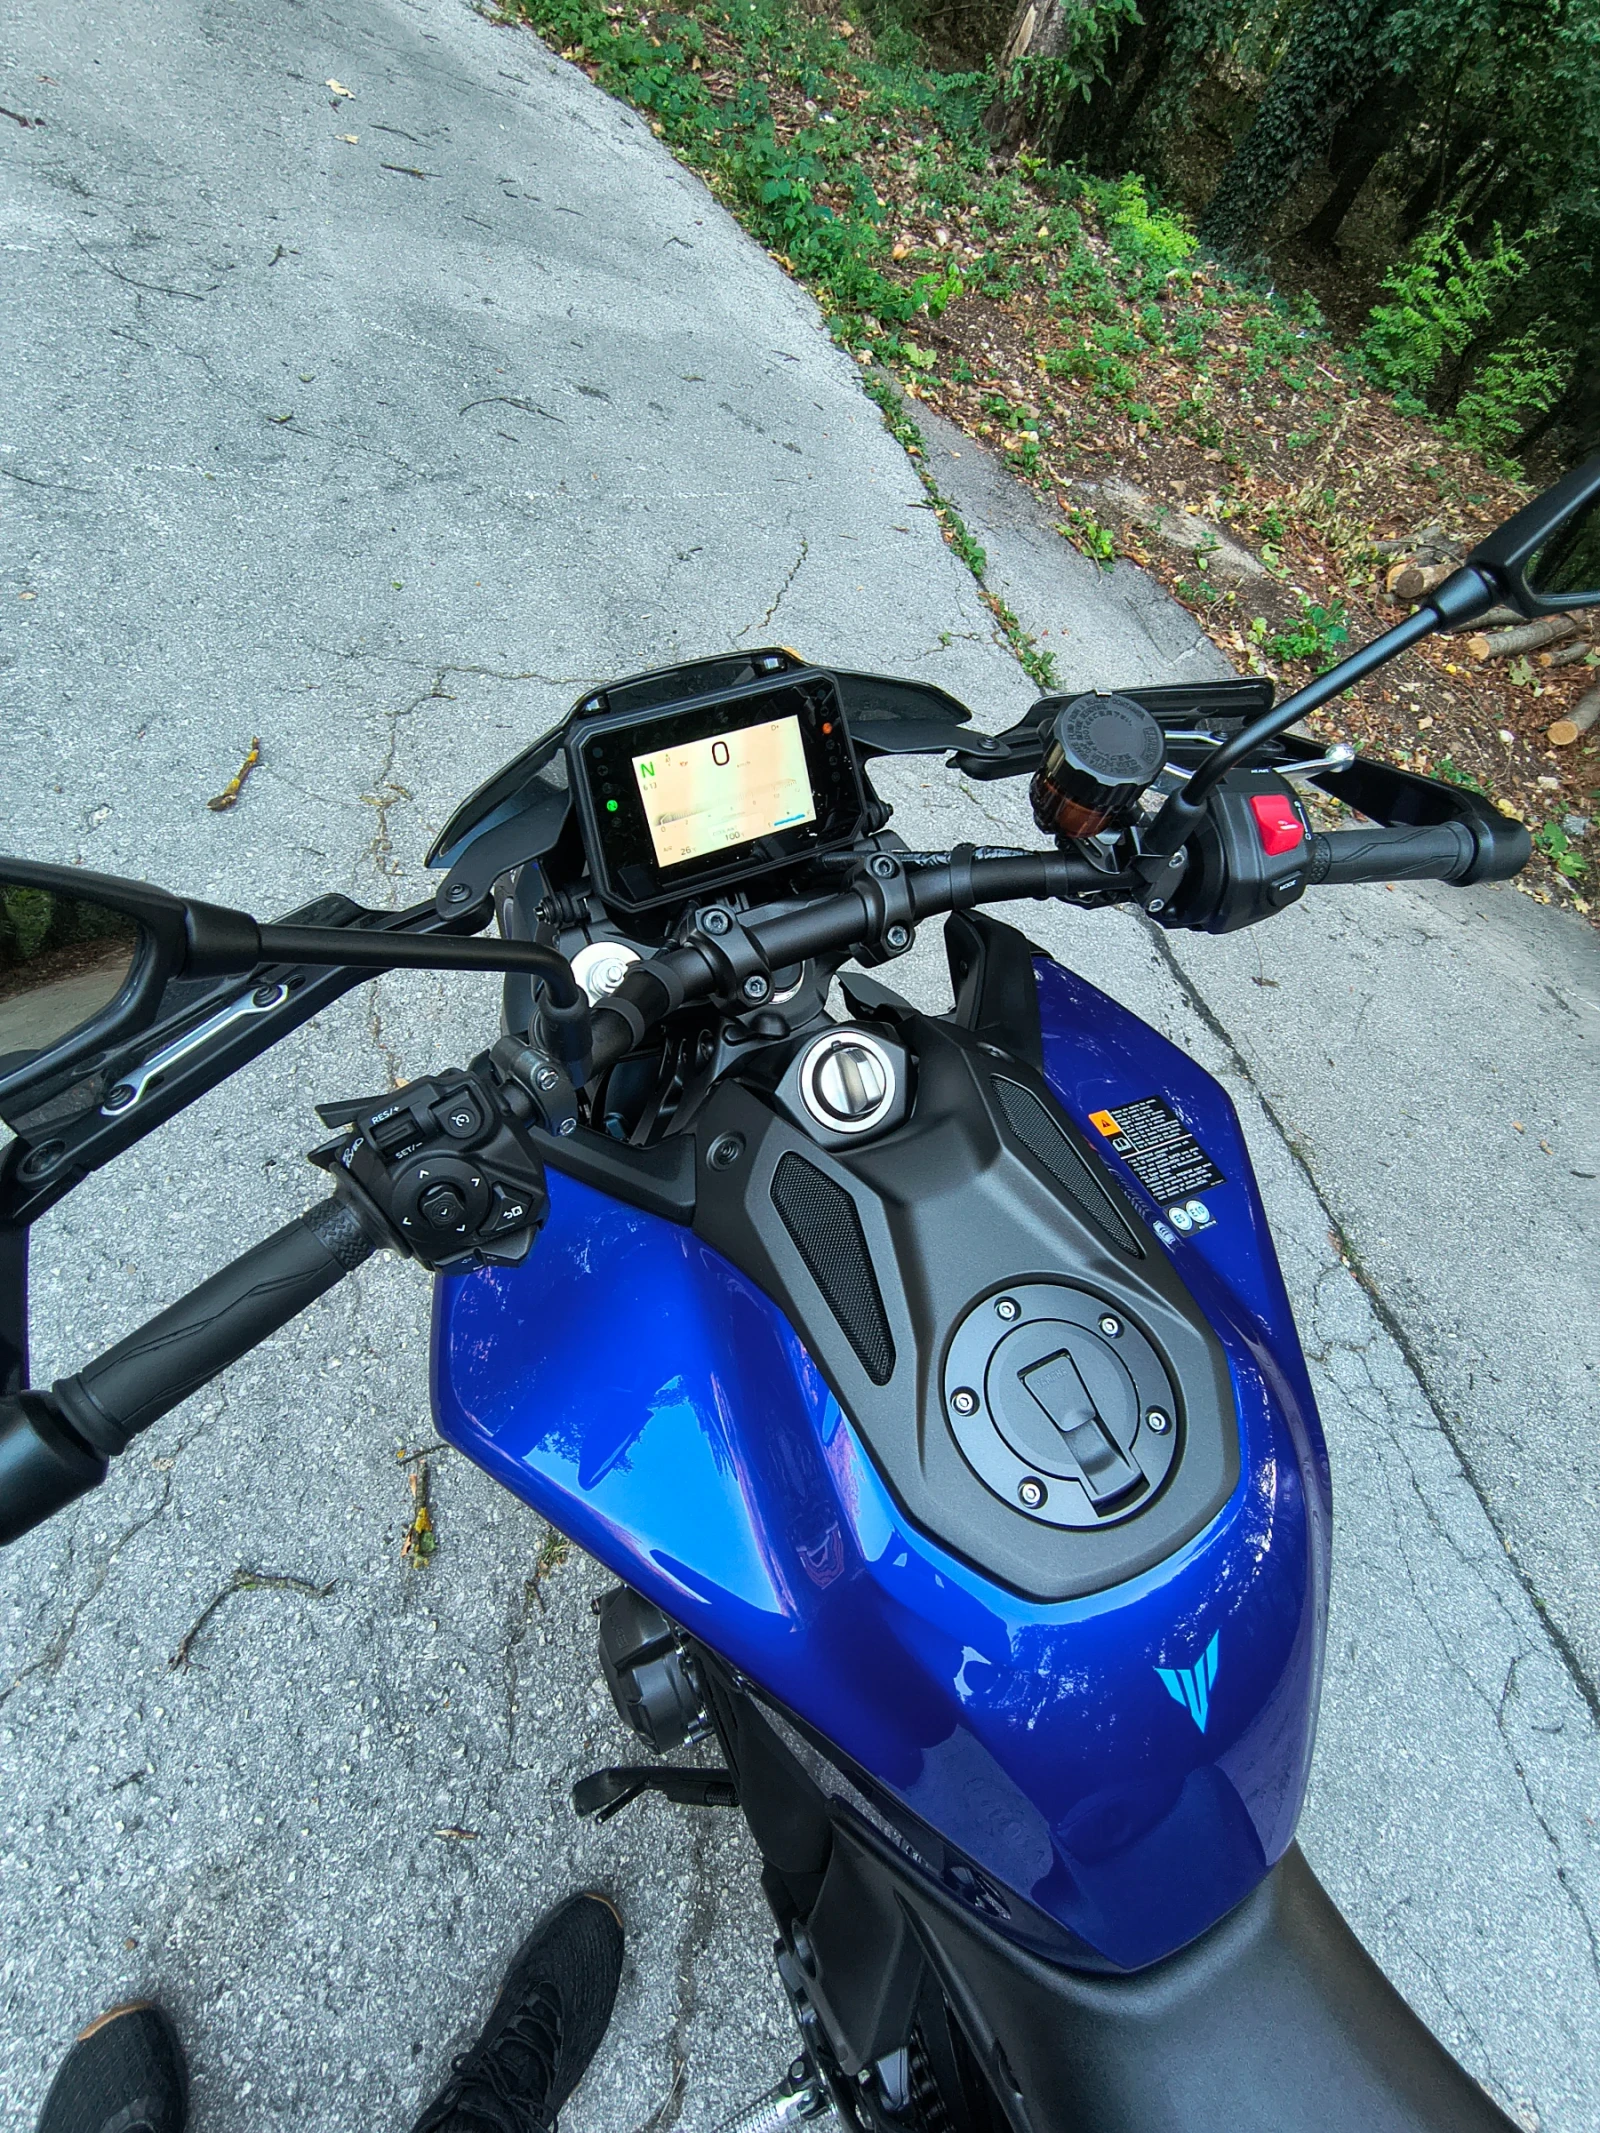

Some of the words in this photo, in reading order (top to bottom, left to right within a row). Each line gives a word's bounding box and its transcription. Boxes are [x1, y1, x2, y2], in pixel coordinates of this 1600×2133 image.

[711, 741, 730, 766] 0
[640, 761, 655, 778] N
[371, 1106, 400, 1125] RES/+
